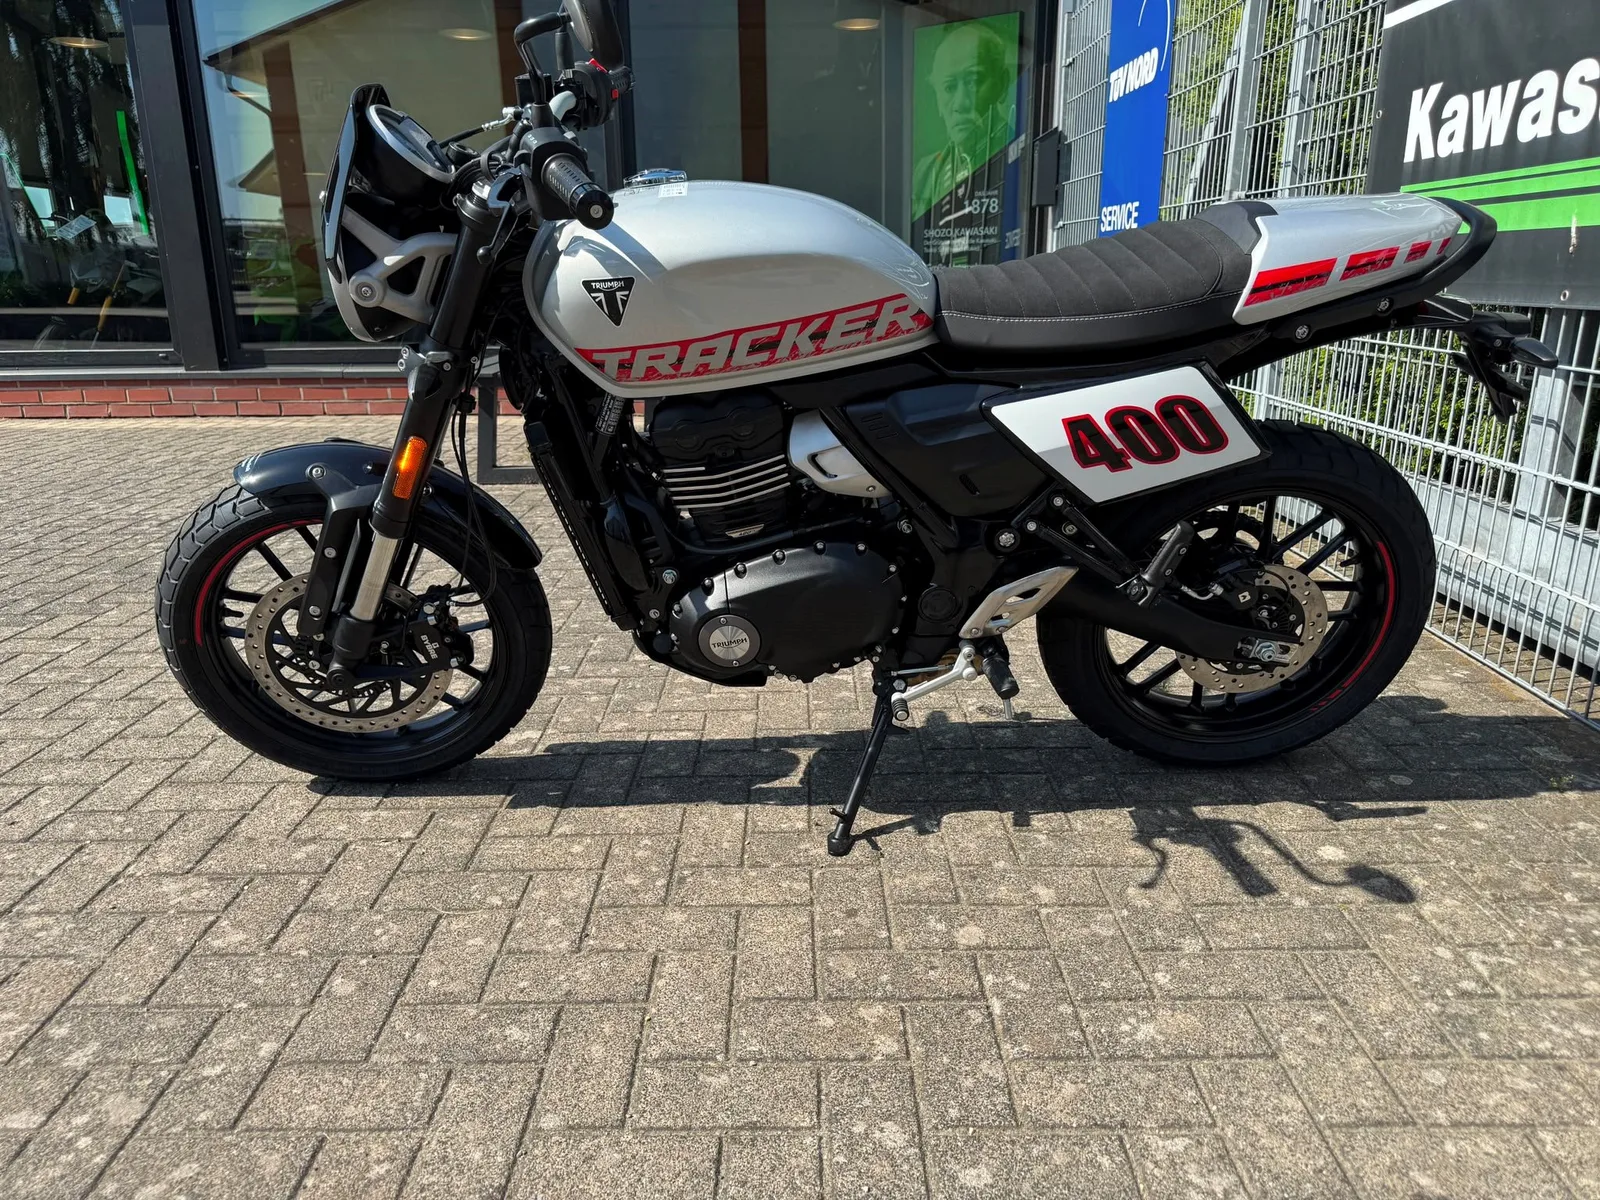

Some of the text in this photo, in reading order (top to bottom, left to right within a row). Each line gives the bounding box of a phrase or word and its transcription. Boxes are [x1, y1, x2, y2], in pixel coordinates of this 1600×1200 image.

[1125, 47, 1159, 94] NORD
[1403, 57, 1600, 164] Kawas
[963, 197, 999, 214] 1878
[1101, 201, 1140, 232] SERVICE
[924, 226, 998, 238] SHOZO KAWASAKI
[590, 280, 625, 291] TRIUMPH
[592, 295, 923, 382] TRACKER
[1062, 394, 1229, 473] 400
[420, 634, 438, 660] BYBRE
[711, 637, 748, 649] TRIUMPH
